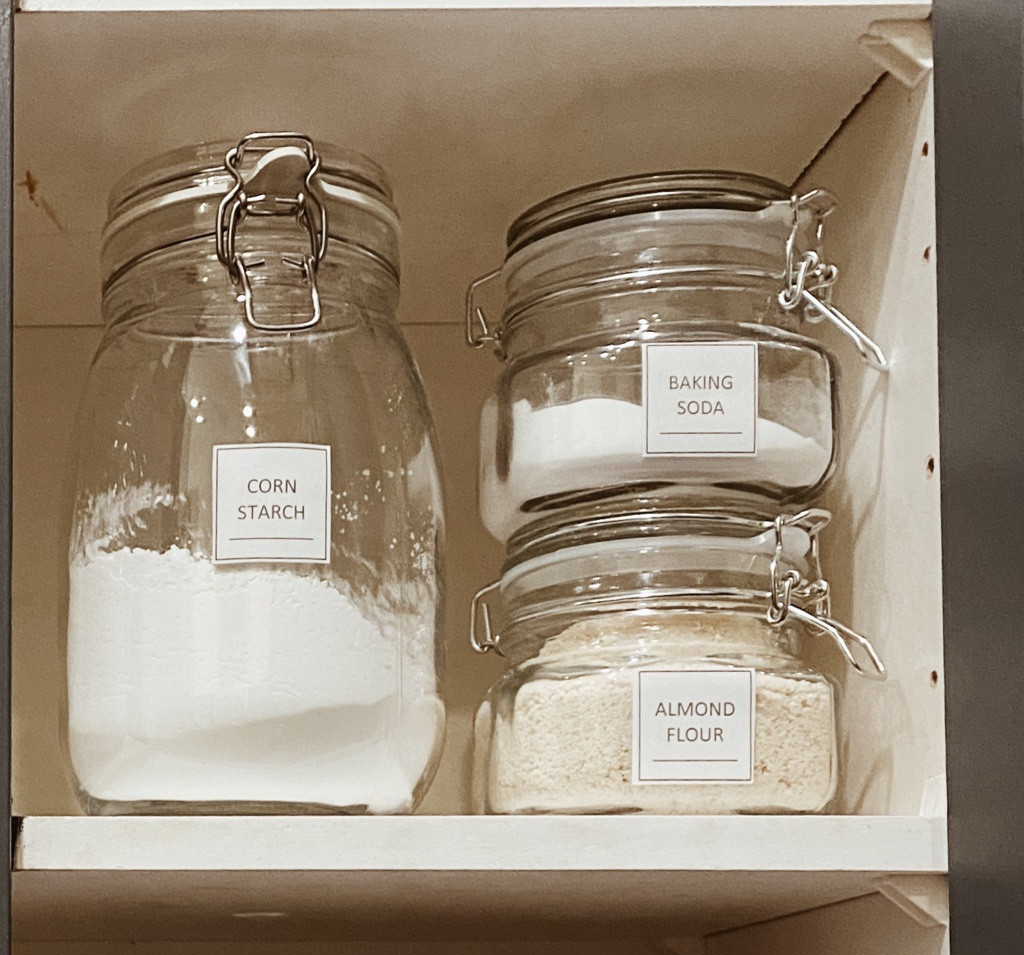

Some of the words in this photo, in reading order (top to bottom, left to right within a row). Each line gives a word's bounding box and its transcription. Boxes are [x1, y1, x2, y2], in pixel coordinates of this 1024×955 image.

[669, 374, 733, 391] BAKING
[676, 400, 725, 416] SODA
[247, 478, 297, 494] CORN
[237, 504, 305, 521] STARCH
[654, 701, 736, 718] ALMOND
[667, 727, 724, 744] FLOUR
